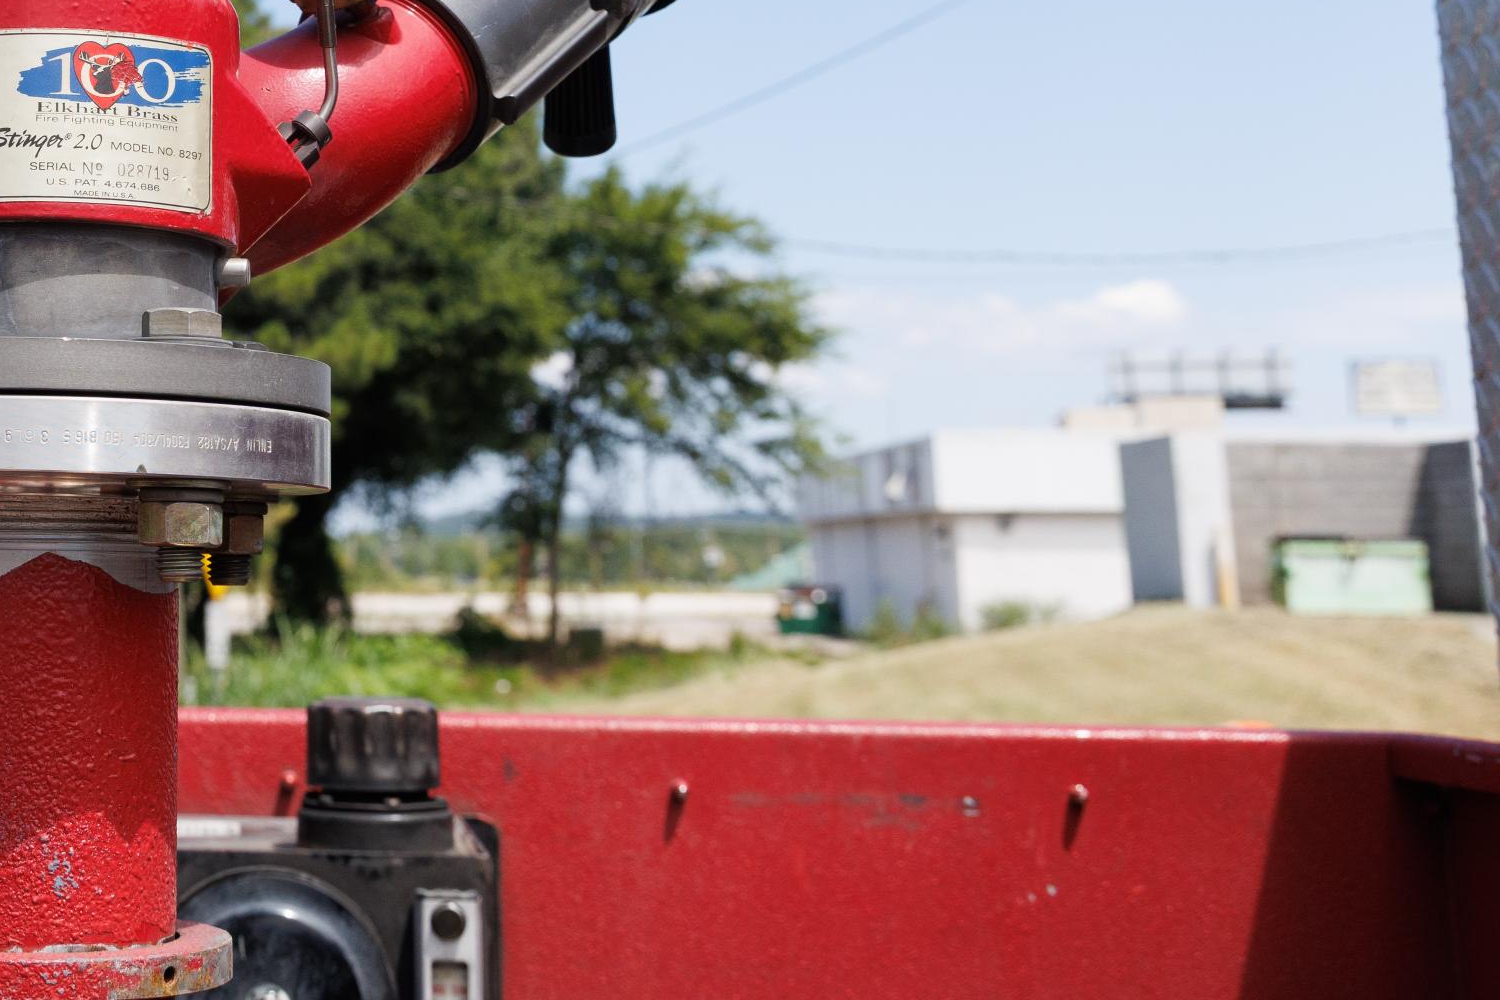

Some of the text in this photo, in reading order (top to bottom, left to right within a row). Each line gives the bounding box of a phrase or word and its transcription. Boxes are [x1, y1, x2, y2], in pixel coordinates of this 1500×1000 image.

[36, 101, 178, 122] Elkhart Brass
[35, 114, 179, 132] Fire Fighting Equipment
[73, 133, 103, 150] 2.0
[110, 141, 153, 154] MODEL
[157, 146, 176, 157] NO.
[178, 149, 202, 161] 8297
[29, 161, 75, 172] SERIAL
[73, 189, 99, 197] MADE
